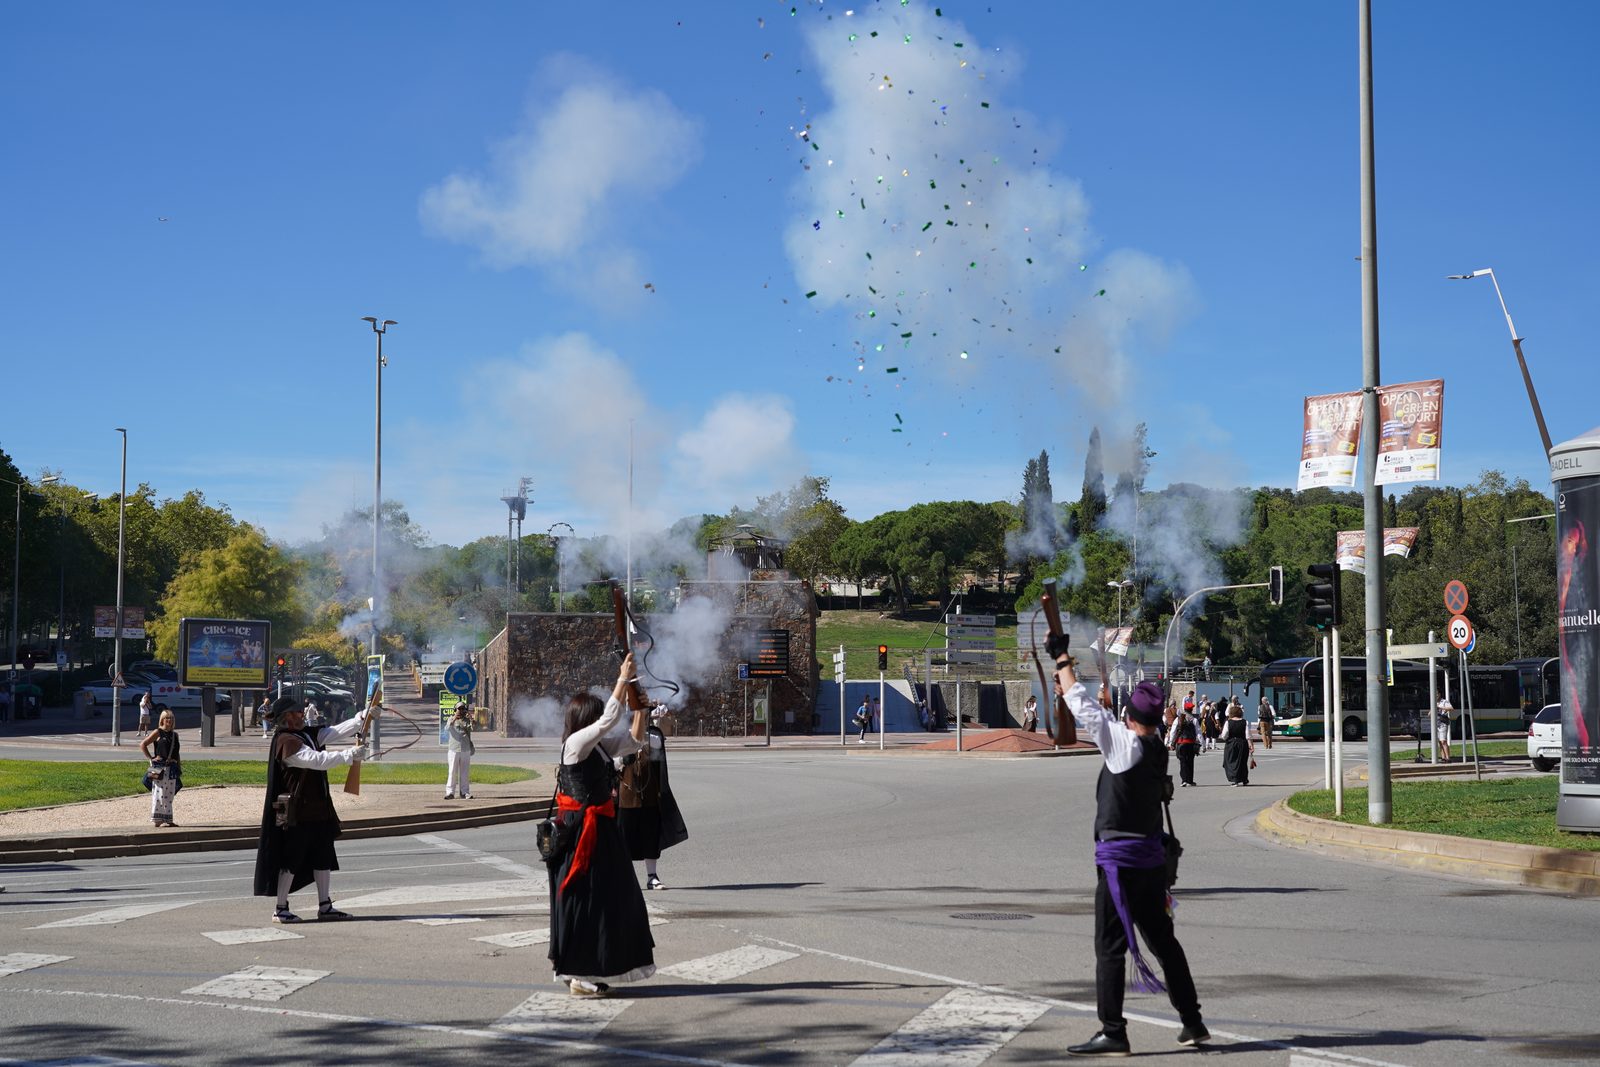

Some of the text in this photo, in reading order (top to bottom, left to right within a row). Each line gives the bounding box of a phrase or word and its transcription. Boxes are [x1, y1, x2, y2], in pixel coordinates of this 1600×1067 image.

[1381, 391, 1412, 407] OPEN
[1402, 400, 1439, 414] GREEN
[1401, 411, 1438, 425] COURT
[203, 626, 226, 635] CIRC
[235, 626, 251, 636] ICE
[1453, 627, 1466, 638] 20
